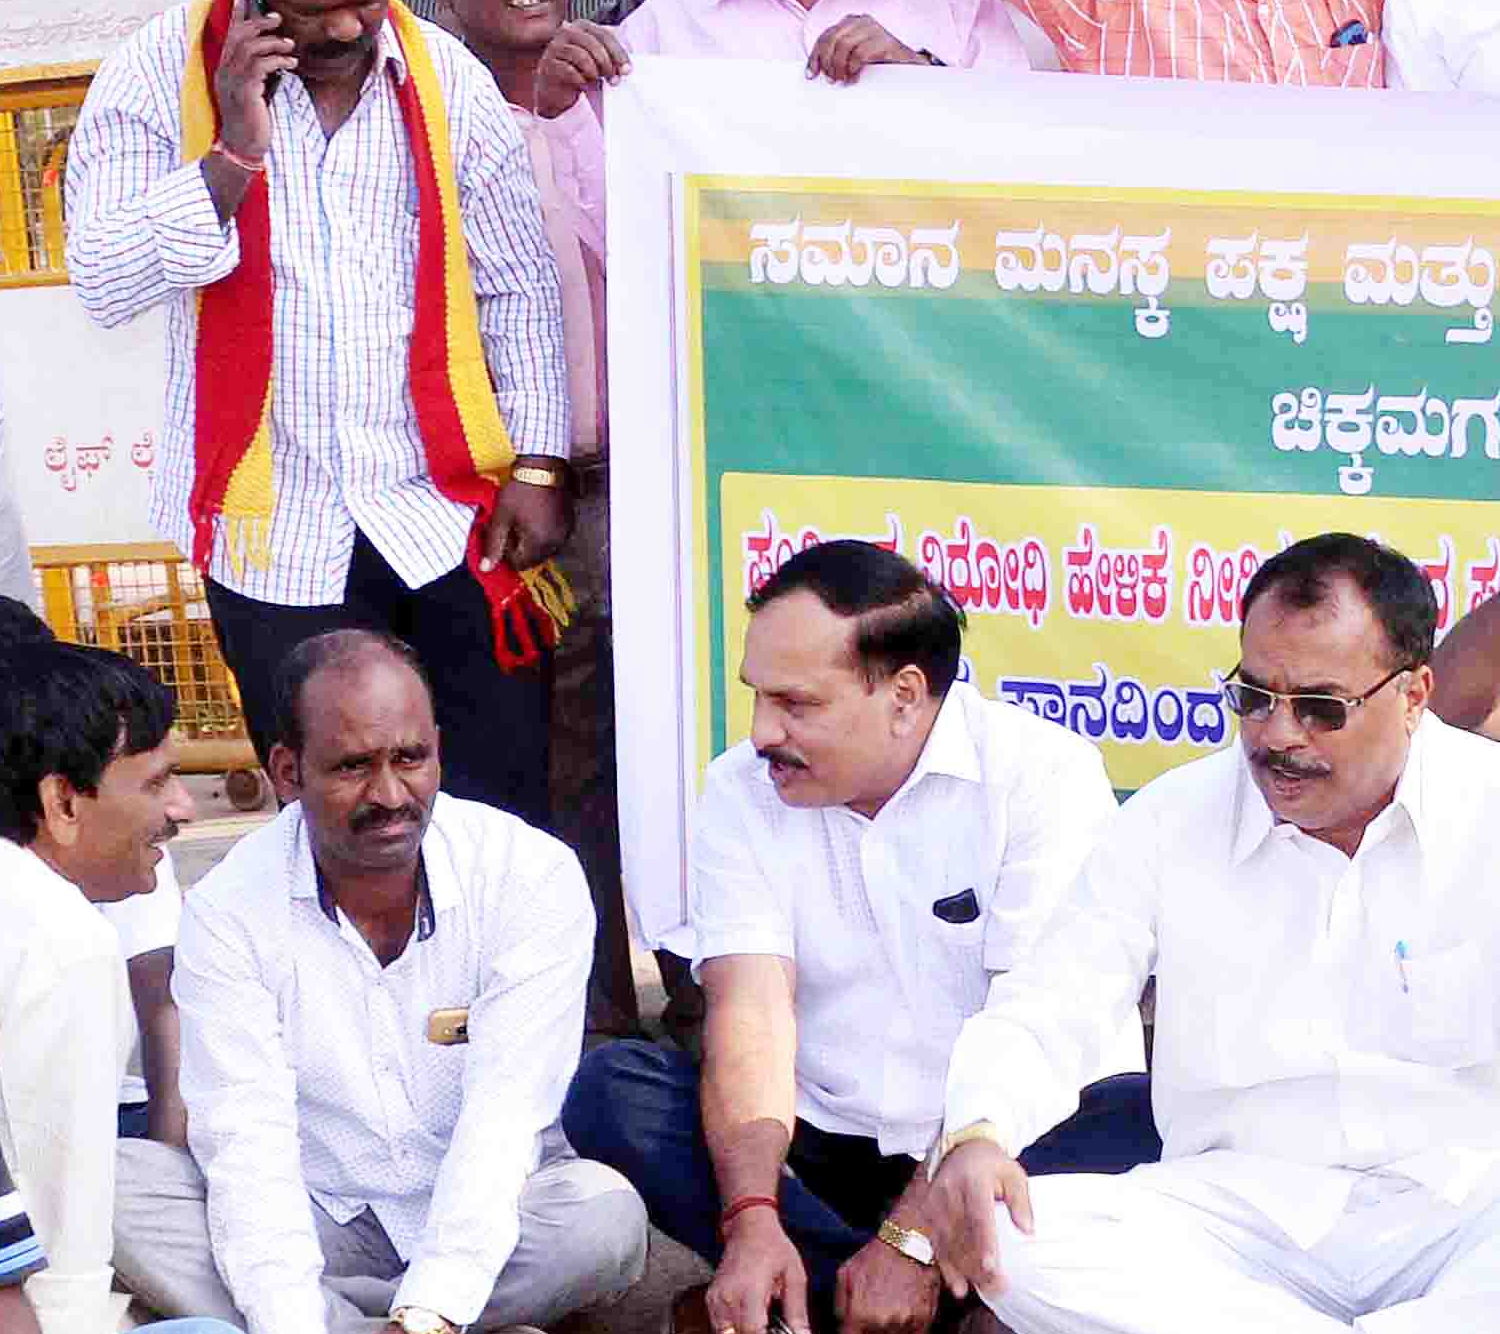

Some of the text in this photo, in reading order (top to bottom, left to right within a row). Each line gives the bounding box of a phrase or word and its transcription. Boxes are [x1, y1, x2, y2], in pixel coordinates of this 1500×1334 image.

[748, 212, 962, 289] ಸಮಾನ
[993, 219, 1173, 339] ಮನಸ್ಕ
[1204, 227, 1309, 345] ಪಕ್ಷ
[1342, 233, 1497, 345] ಮತ್ತು
[1063, 525, 1174, 622] ಹೇಳಿಕೆ
